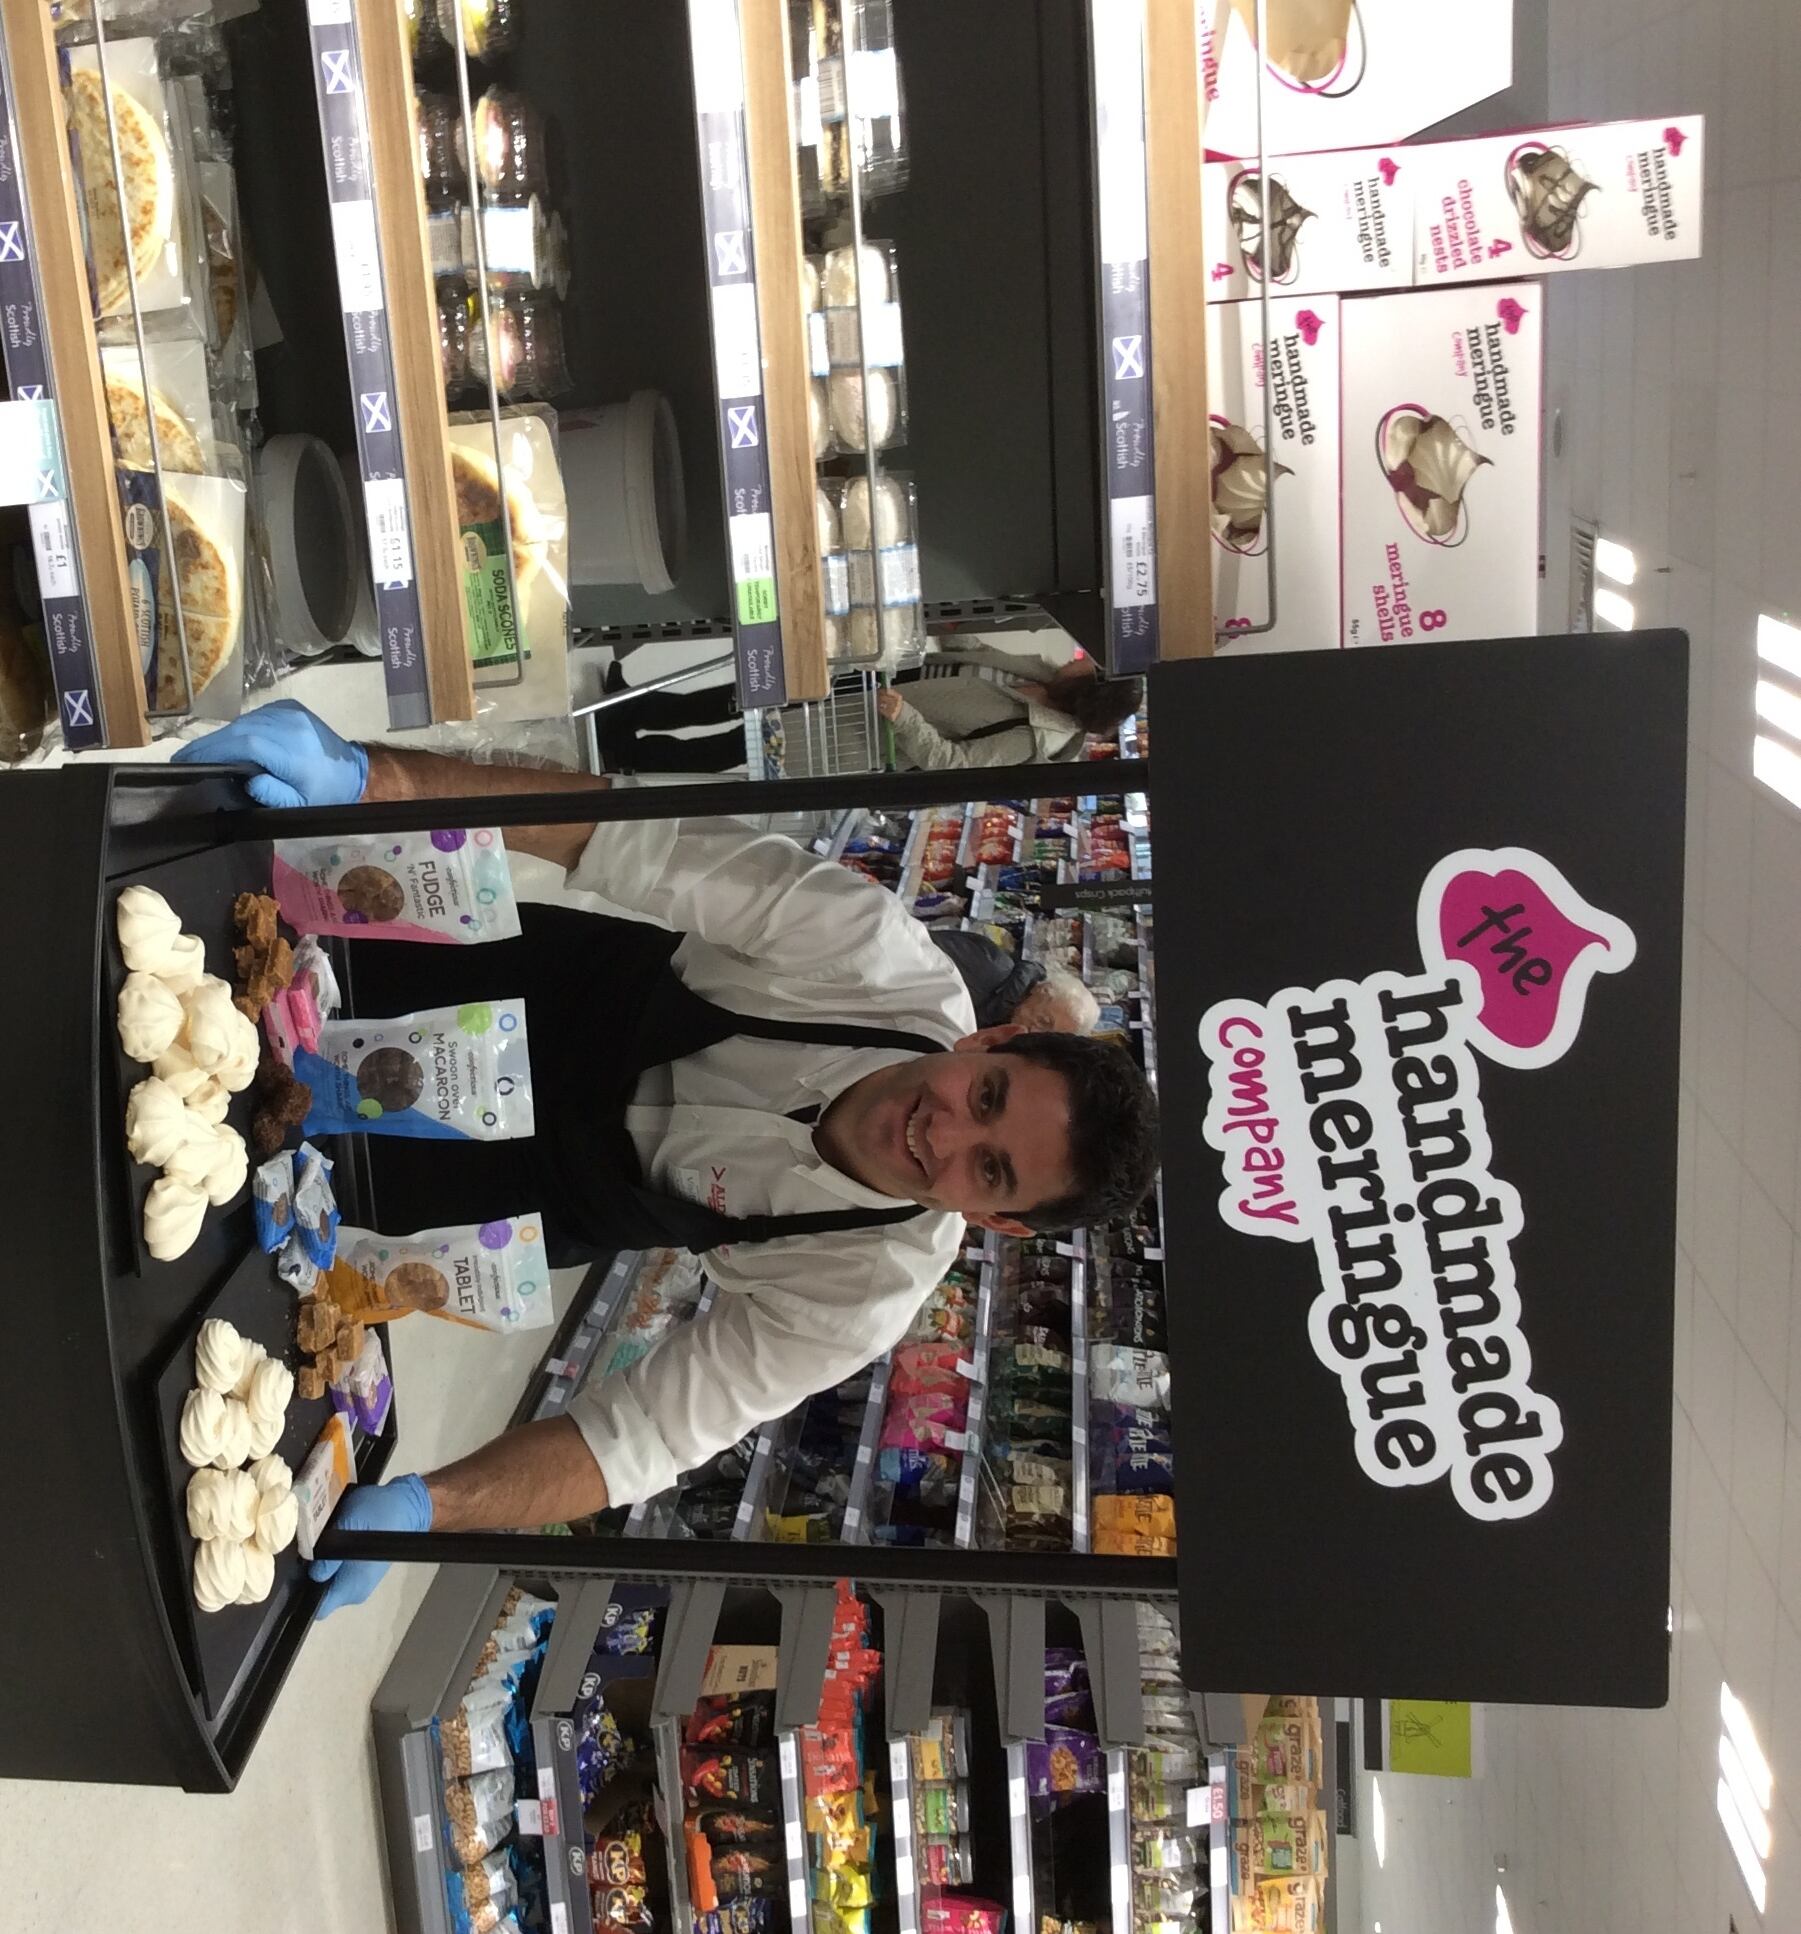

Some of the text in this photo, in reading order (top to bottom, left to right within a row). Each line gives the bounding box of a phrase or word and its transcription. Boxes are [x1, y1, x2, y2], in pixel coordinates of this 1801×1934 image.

[330, 136, 346, 183] Scottish
[345, 136, 360, 182] Proudly
[1638, 152, 1661, 236] meringue
[1652, 147, 1678, 240] handmade
[1352, 181, 1376, 263] meringue
[1368, 176, 1392, 268] handmade
[1441, 196, 1467, 270] drizzled
[1457, 179, 1484, 265] chocolate
[1429, 224, 1450, 274] nests
[1488, 238, 1512, 259] 4
[1212, 262, 1235, 282] 4
[4, 304, 21, 348] Scottish
[20, 302, 35, 346] Proudly
[1269, 339, 1296, 440] meringue
[1283, 333, 1316, 446] handmade
[1466, 327, 1496, 430] meringue
[1484, 322, 1516, 436] handmade
[1114, 422, 1132, 470] Scottish
[1130, 419, 1146, 468] Proudly
[56, 554, 68, 568] £1
[390, 538, 403, 570] £1.15
[492, 569, 507, 602] SODA
[1136, 562, 1148, 596] £2.75
[1385, 542, 1414, 638] meringue
[52, 613, 68, 654] Scottish
[68, 611, 82, 652] Proudly
[140, 609, 150, 647] SCOTTISH
[497, 604, 517, 650] SCONES
[1372, 584, 1395, 642] shells
[1418, 609, 1448, 632] 8
[388, 627, 401, 669] Scottish
[402, 625, 416, 668] Proudly
[761, 646, 775, 690] Proudly
[746, 649, 760, 692] Scottish
[409, 878, 425, 920] Fantastic
[418, 861, 446, 918] FUDGE
[1456, 904, 1555, 997] the
[432, 1033, 450, 1120] MACAROON
[448, 1042, 460, 1110] Swoon over
[1218, 1016, 1299, 1226] company
[1288, 998, 1439, 1471] meringue
[1377, 978, 1543, 1504] handmade
[453, 1257, 475, 1314] TABLET
[604, 1607, 618, 1626] KP
[582, 1676, 596, 1697] KP
[560, 1726, 571, 1749] KP
[1283, 1724, 1302, 1774] graze
[1212, 1787, 1224, 1819] £1.50
[1234, 1760, 1250, 1800] graze
[571, 1852, 582, 1873] KP
[1236, 1842, 1250, 1880] graze
[1288, 1816, 1307, 1864] graze
[610, 1850, 626, 1882] KP
[610, 1896, 626, 1924] KP
[1288, 1882, 1306, 1929] graze
